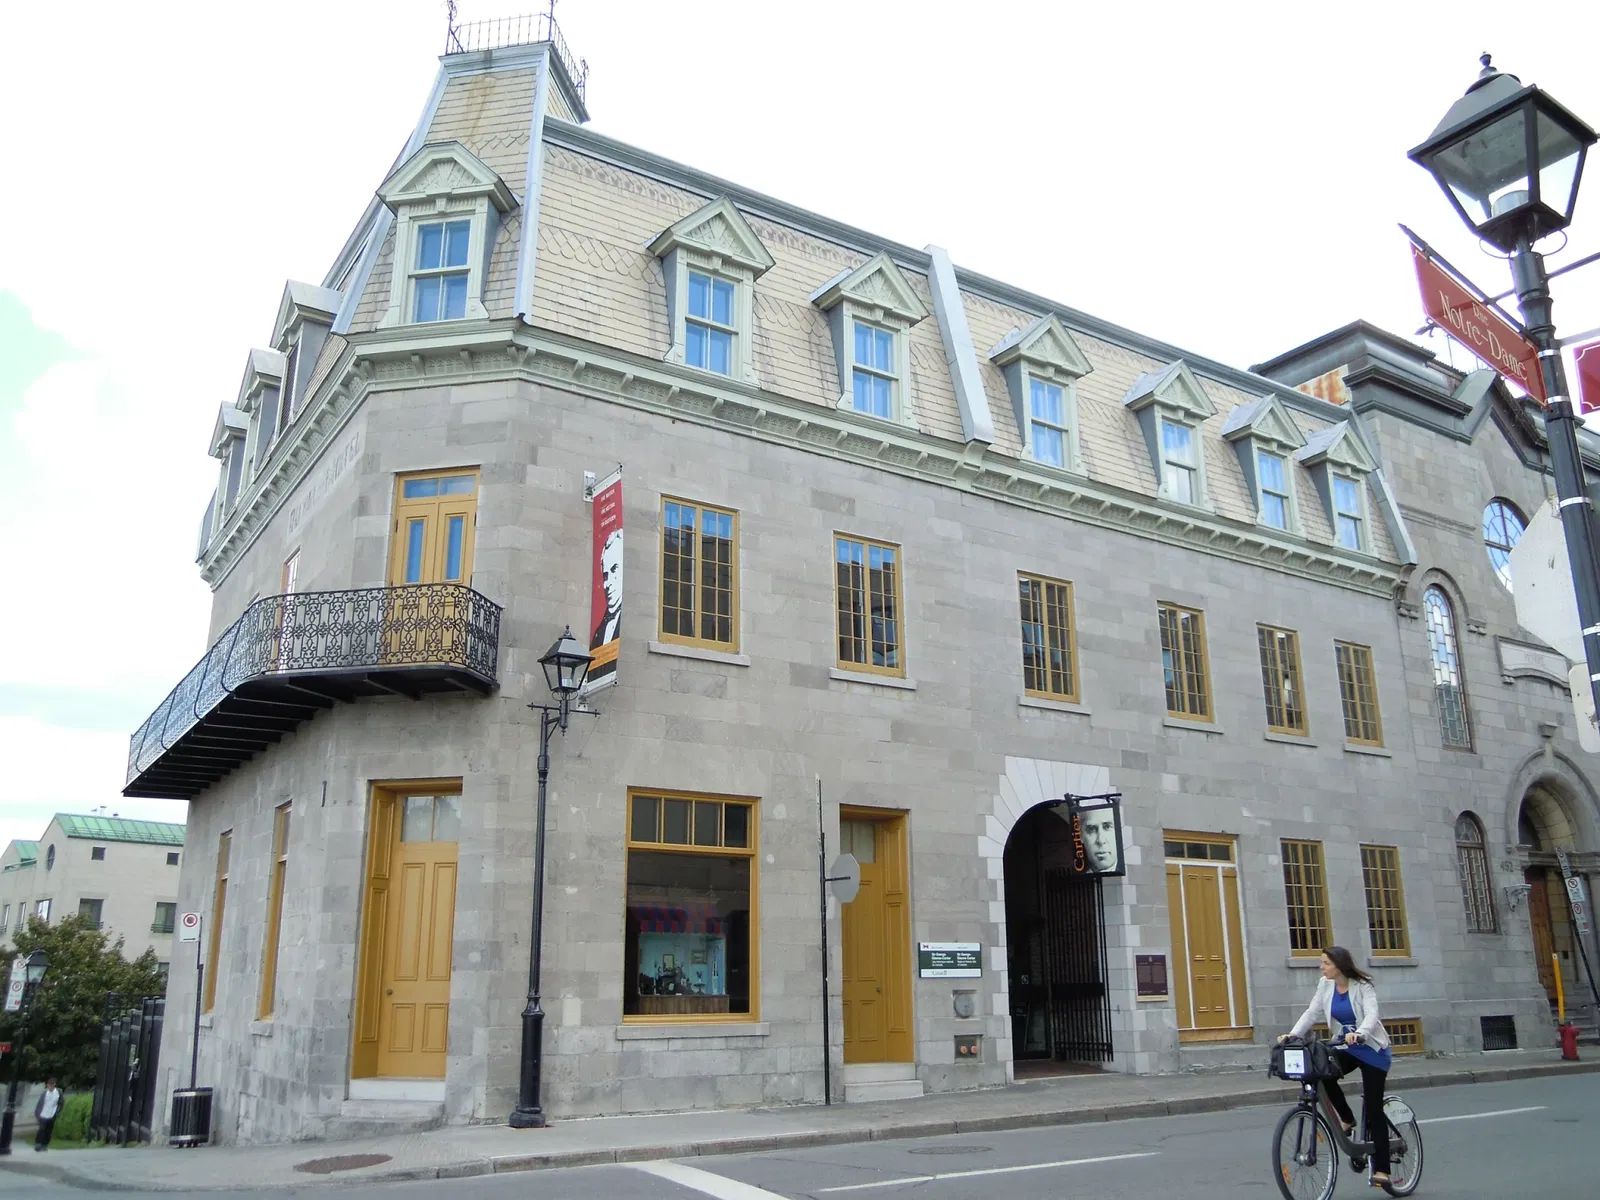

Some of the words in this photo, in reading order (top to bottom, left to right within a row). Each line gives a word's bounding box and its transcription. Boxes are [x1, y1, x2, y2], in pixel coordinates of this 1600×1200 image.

[1439, 290, 1527, 381] Notre-Dame
[1472, 302, 1489, 326] Rue
[1072, 815, 1086, 872] Cartier
